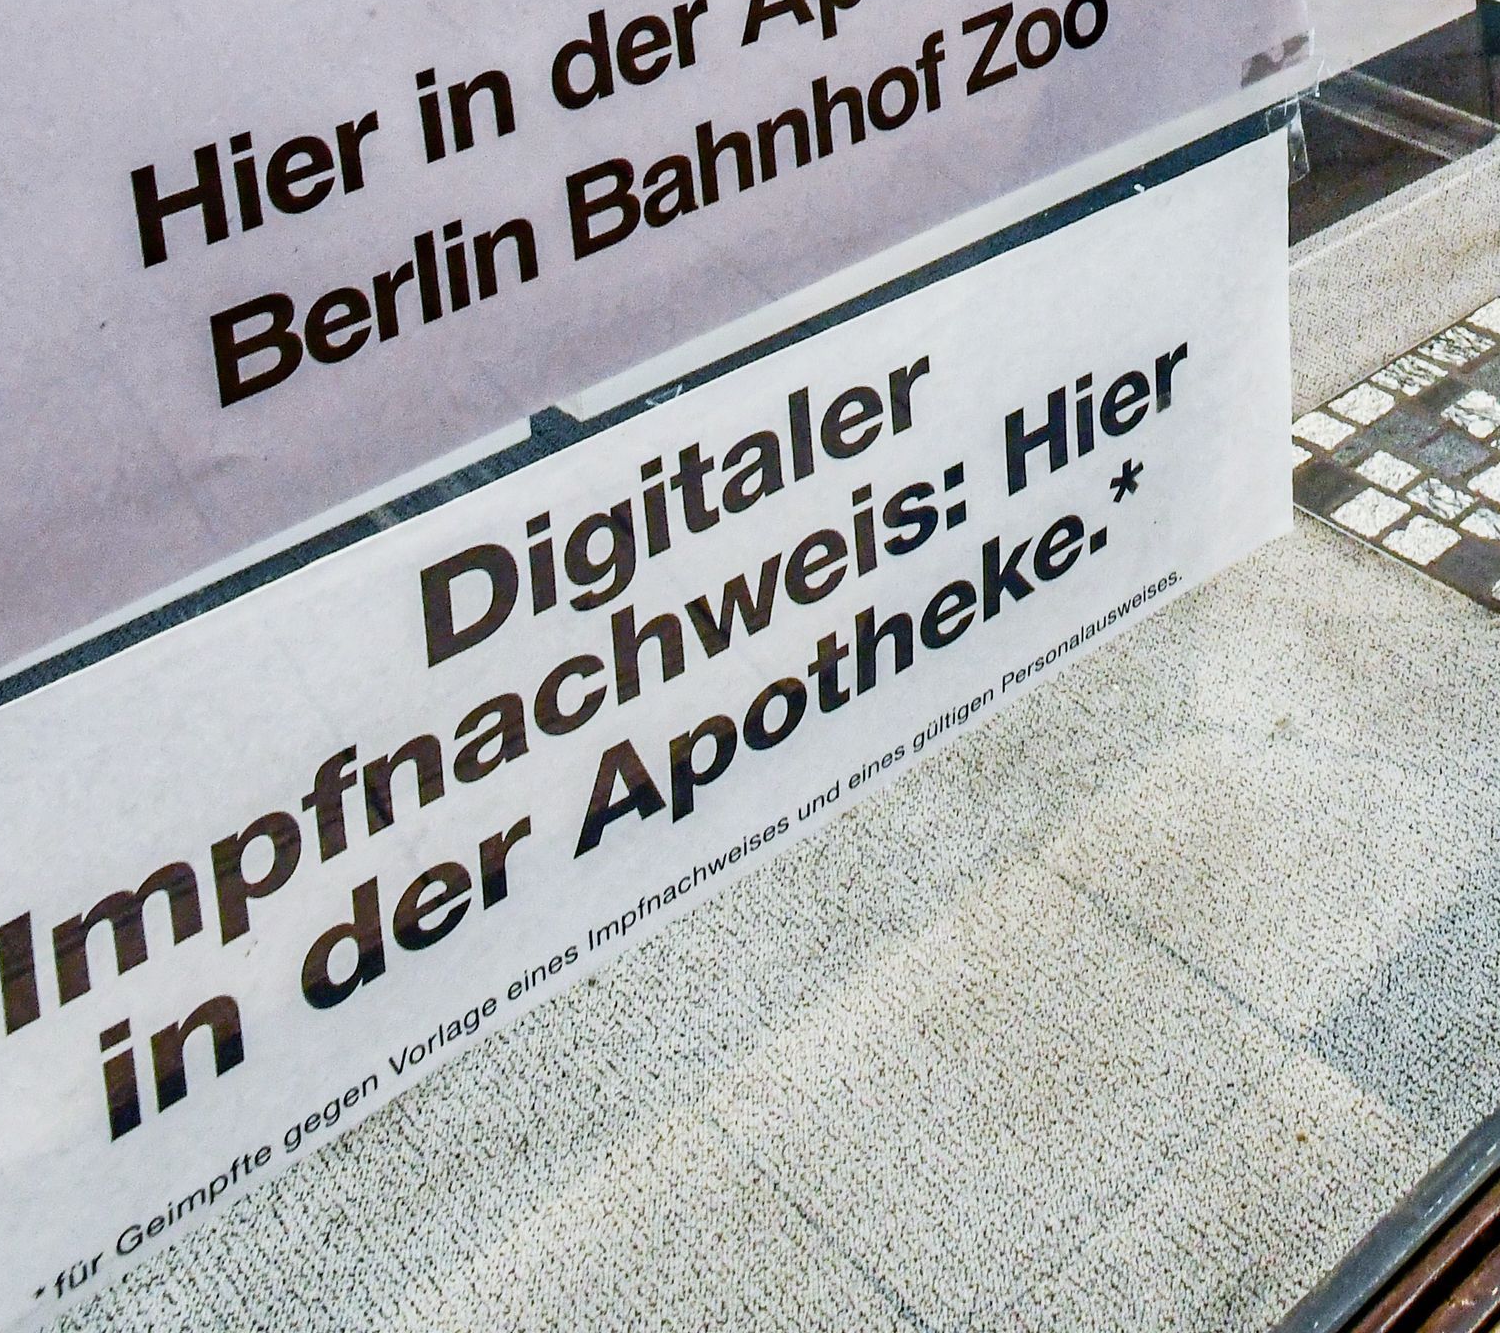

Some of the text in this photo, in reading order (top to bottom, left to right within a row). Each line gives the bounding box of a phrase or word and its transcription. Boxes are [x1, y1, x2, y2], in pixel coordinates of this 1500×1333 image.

[129, 108, 380, 270] Hier
[414, 66, 517, 165] in
[207, 217, 540, 410] Berlin
[564, 33, 945, 265] Bahnhof
[418, 352, 932, 670] Digitaler
[1002, 340, 1192, 498] Hier
[99, 992, 246, 1144] in
[298, 815, 536, 1013] der
[113, 1143, 274, 1258] Geimpfte
[282, 1072, 380, 1156] gegen
[387, 994, 499, 1079] Vorlage
[506, 942, 580, 1004] eines
[587, 813, 791, 955] Impfnachweises
[796, 777, 842, 823] und
[846, 741, 907, 791] eines
[912, 684, 998, 757] gültigen
[999, 567, 1186, 696] Personalausweises.
